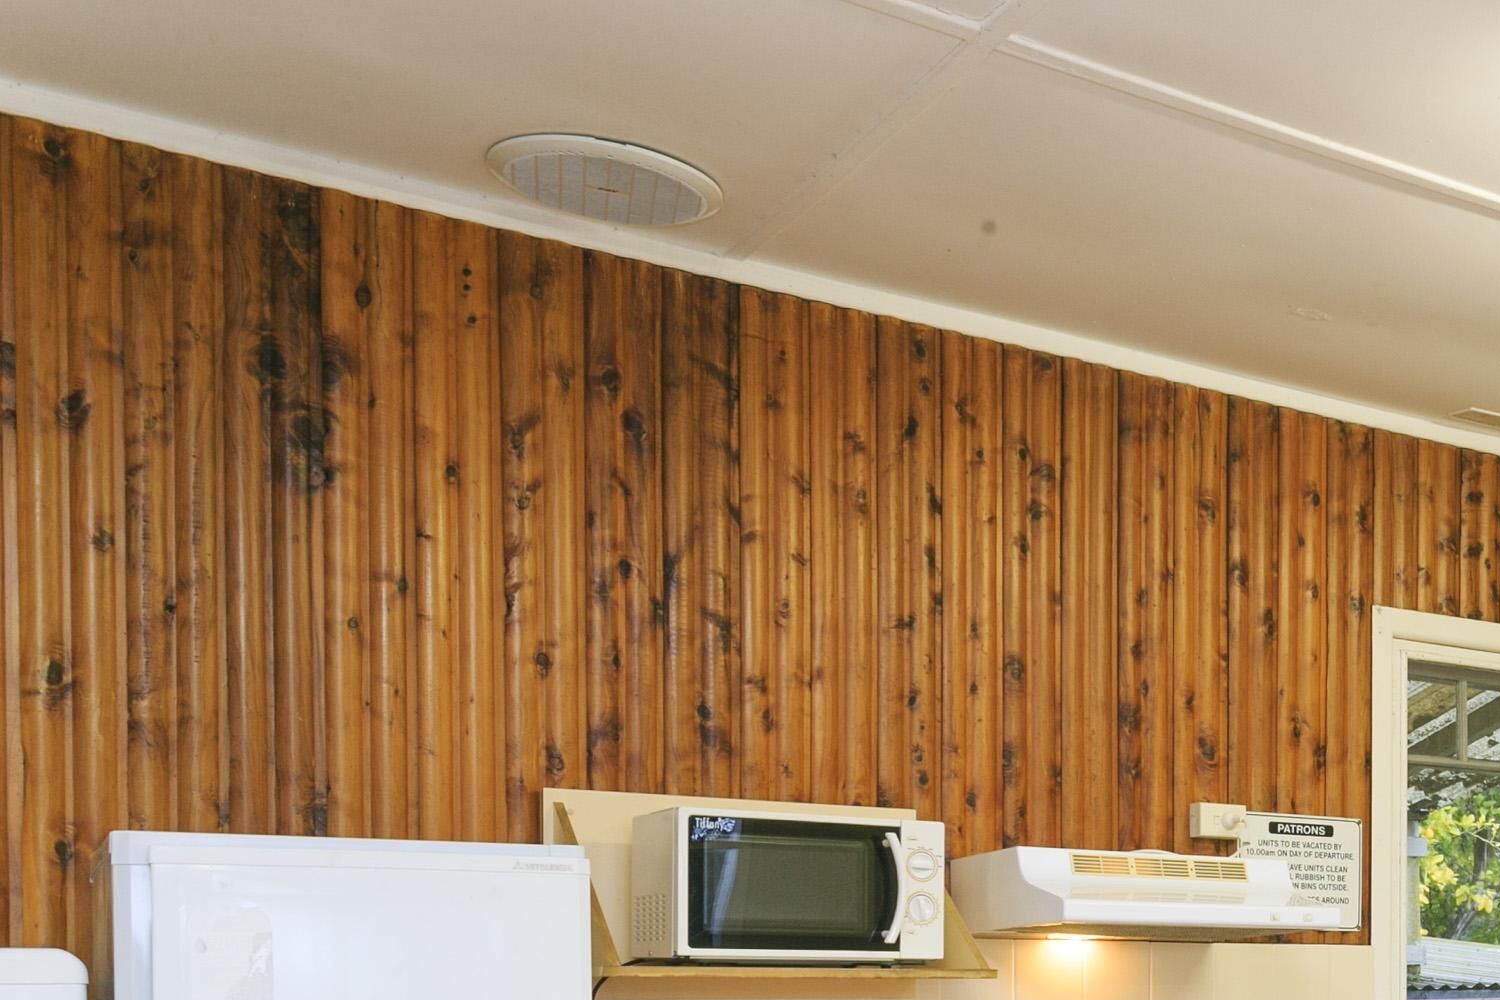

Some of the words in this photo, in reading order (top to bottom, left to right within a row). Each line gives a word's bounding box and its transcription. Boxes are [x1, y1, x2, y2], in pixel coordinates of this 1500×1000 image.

[1277, 824, 1326, 836] PATRONS
[1257, 839, 1279, 848] UNITS
[1280, 840, 1290, 848] TO
[1291, 841, 1301, 849] BE
[1302, 841, 1333, 851] VACATED
[1333, 843, 1343, 851] BY
[1277, 849, 1288, 857] ON
[1289, 850, 1302, 858] DAY
[1287, 863, 1303, 871] AVE
[1303, 864, 1325, 873] UNITS
[1325, 865, 1348, 873] CLEAN
[1295, 873, 1325, 882] RUBBISH
[1326, 874, 1336, 882] TO
[1337, 874, 1346, 882] BE
[1300, 882, 1318, 890] BINS
[1320, 896, 1350, 905] AROUND
